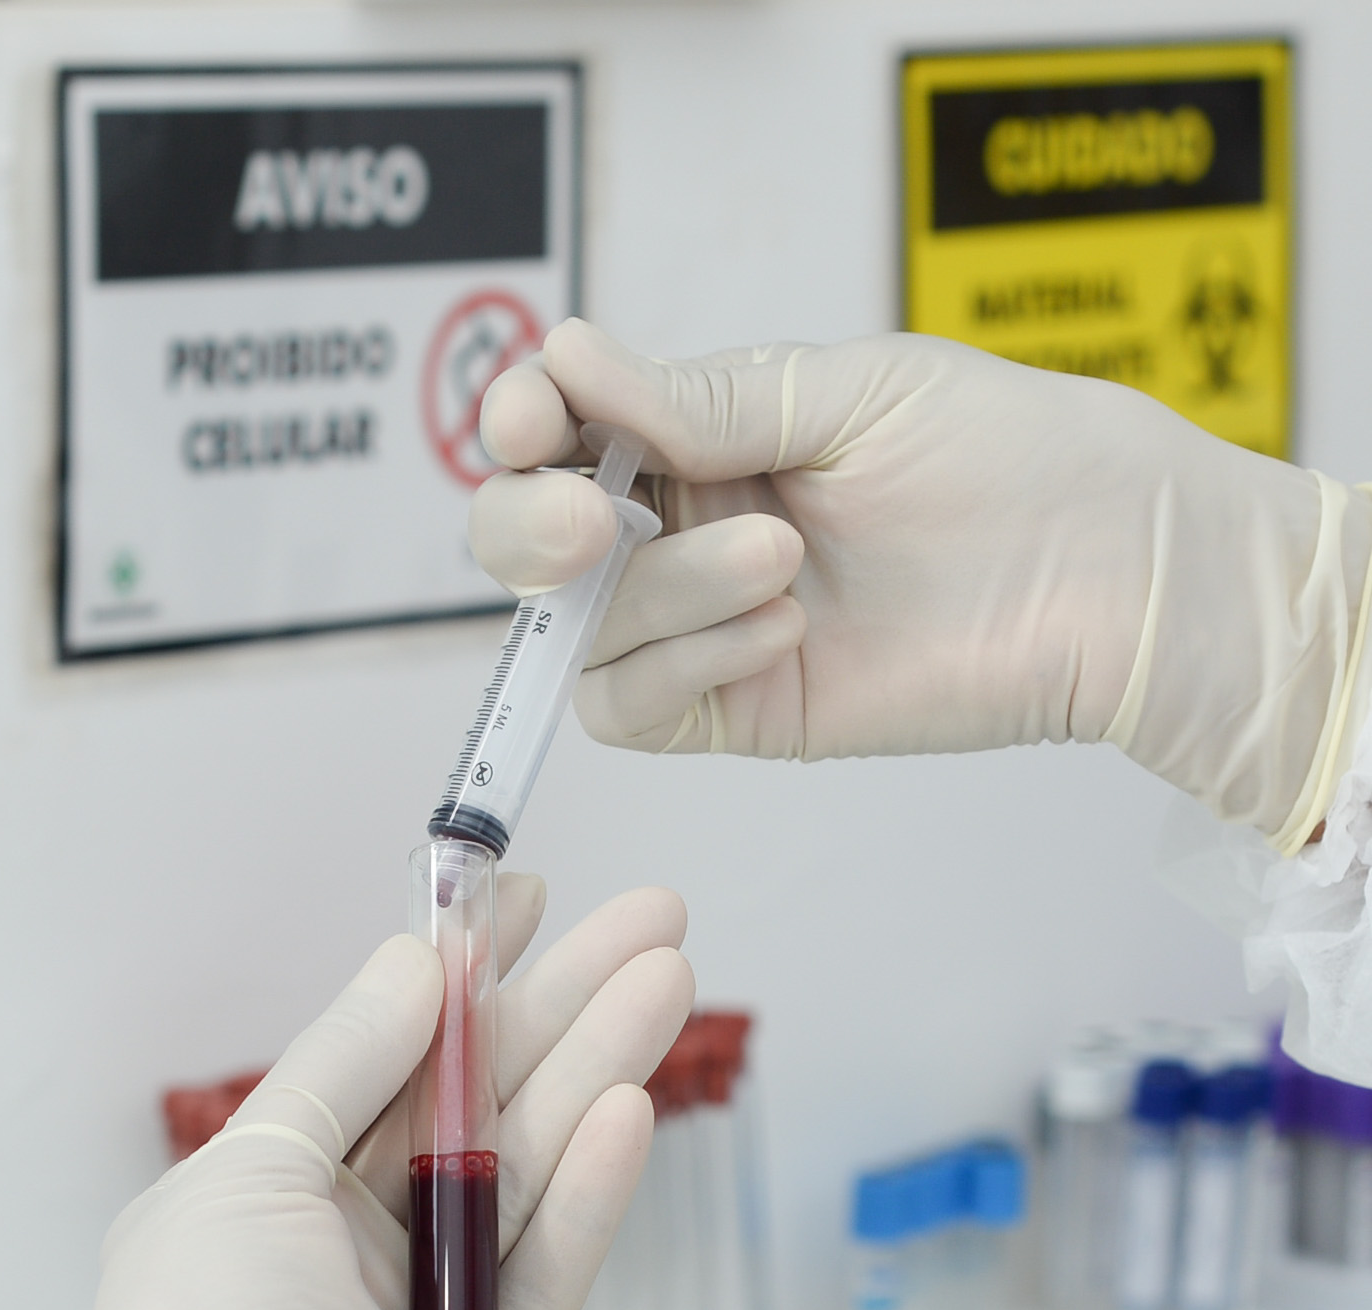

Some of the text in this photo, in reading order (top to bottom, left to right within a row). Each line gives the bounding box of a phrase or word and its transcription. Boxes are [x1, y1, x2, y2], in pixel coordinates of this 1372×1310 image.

[983, 105, 1216, 196] CUIDADO
[234, 145, 432, 231] AVISO
[167, 328, 392, 388] PROIBIDO
[182, 413, 374, 472] CELULAR
[532, 610, 552, 635] SR
[492, 703, 512, 731] 5 ML
